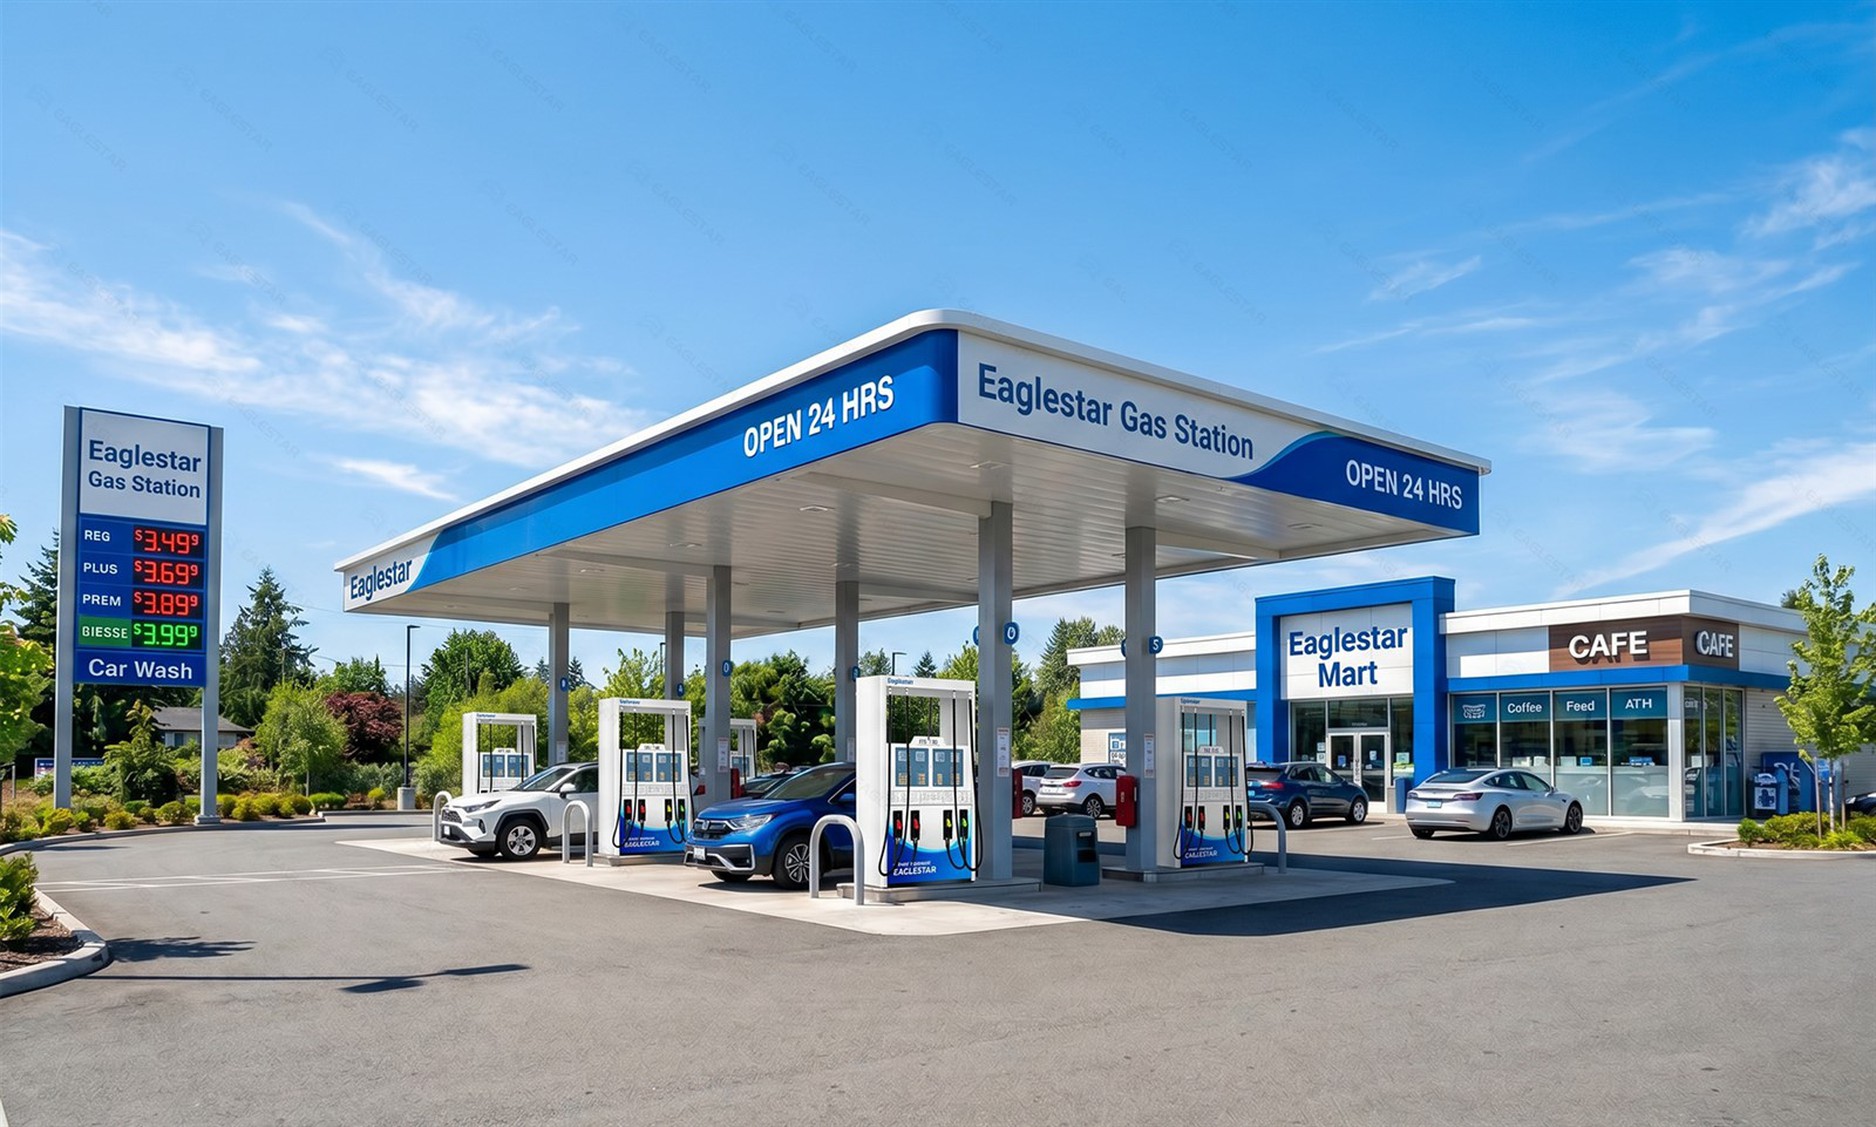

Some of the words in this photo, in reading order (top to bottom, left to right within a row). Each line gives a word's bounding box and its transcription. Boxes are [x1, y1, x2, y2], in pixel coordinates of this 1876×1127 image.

[743, 411, 802, 458] OPEN
[808, 403, 836, 437] 24
[841, 375, 894, 424] HRS
[978, 362, 1112, 426] Eaglestar
[1120, 401, 1167, 440] Gas
[1174, 414, 1254, 460] Station
[88, 440, 202, 472] Eaglestar
[88, 471, 126, 490] Gas
[132, 475, 201, 498] Station
[1346, 459, 1398, 496] OPEN
[1402, 474, 1424, 501] 24
[1428, 479, 1463, 510] HRS
[84, 530, 110, 542] REG
[83, 562, 118, 574] PLUS
[350, 558, 413, 601] Eaglestar
[82, 594, 121, 606] PREM
[1290, 627, 1408, 660] Eaglestar
[1568, 630, 1648, 660] CAFE
[1696, 630, 1734, 658] CAFE
[88, 658, 128, 677] Car
[134, 661, 192, 679] Wash
[1318, 661, 1378, 688] Mart
[1507, 702, 1543, 714] Coffee
[1566, 700, 1595, 712] Feed
[1625, 698, 1652, 709] ATH
